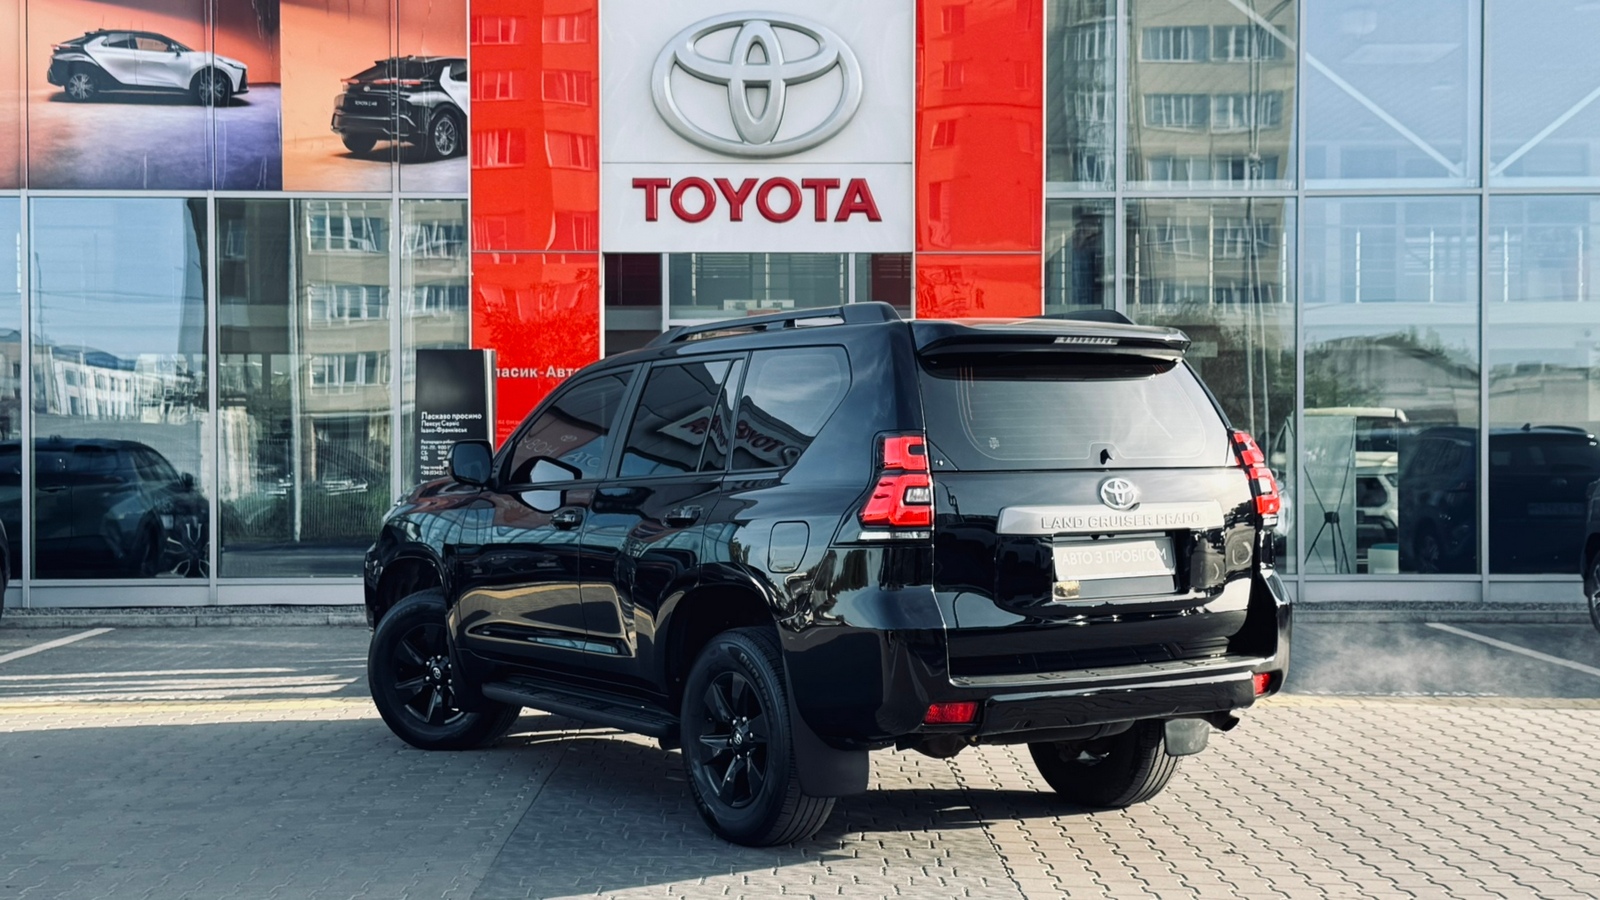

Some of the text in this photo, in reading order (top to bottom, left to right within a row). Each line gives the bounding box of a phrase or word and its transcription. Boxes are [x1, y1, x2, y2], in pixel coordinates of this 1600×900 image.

[631, 175, 883, 225] TOYOTA
[1041, 511, 1199, 529] LAND CRUISER PRADO
[1062, 550, 1092, 566] АВТО
[1105, 547, 1167, 564] ПРОБІГОМ
